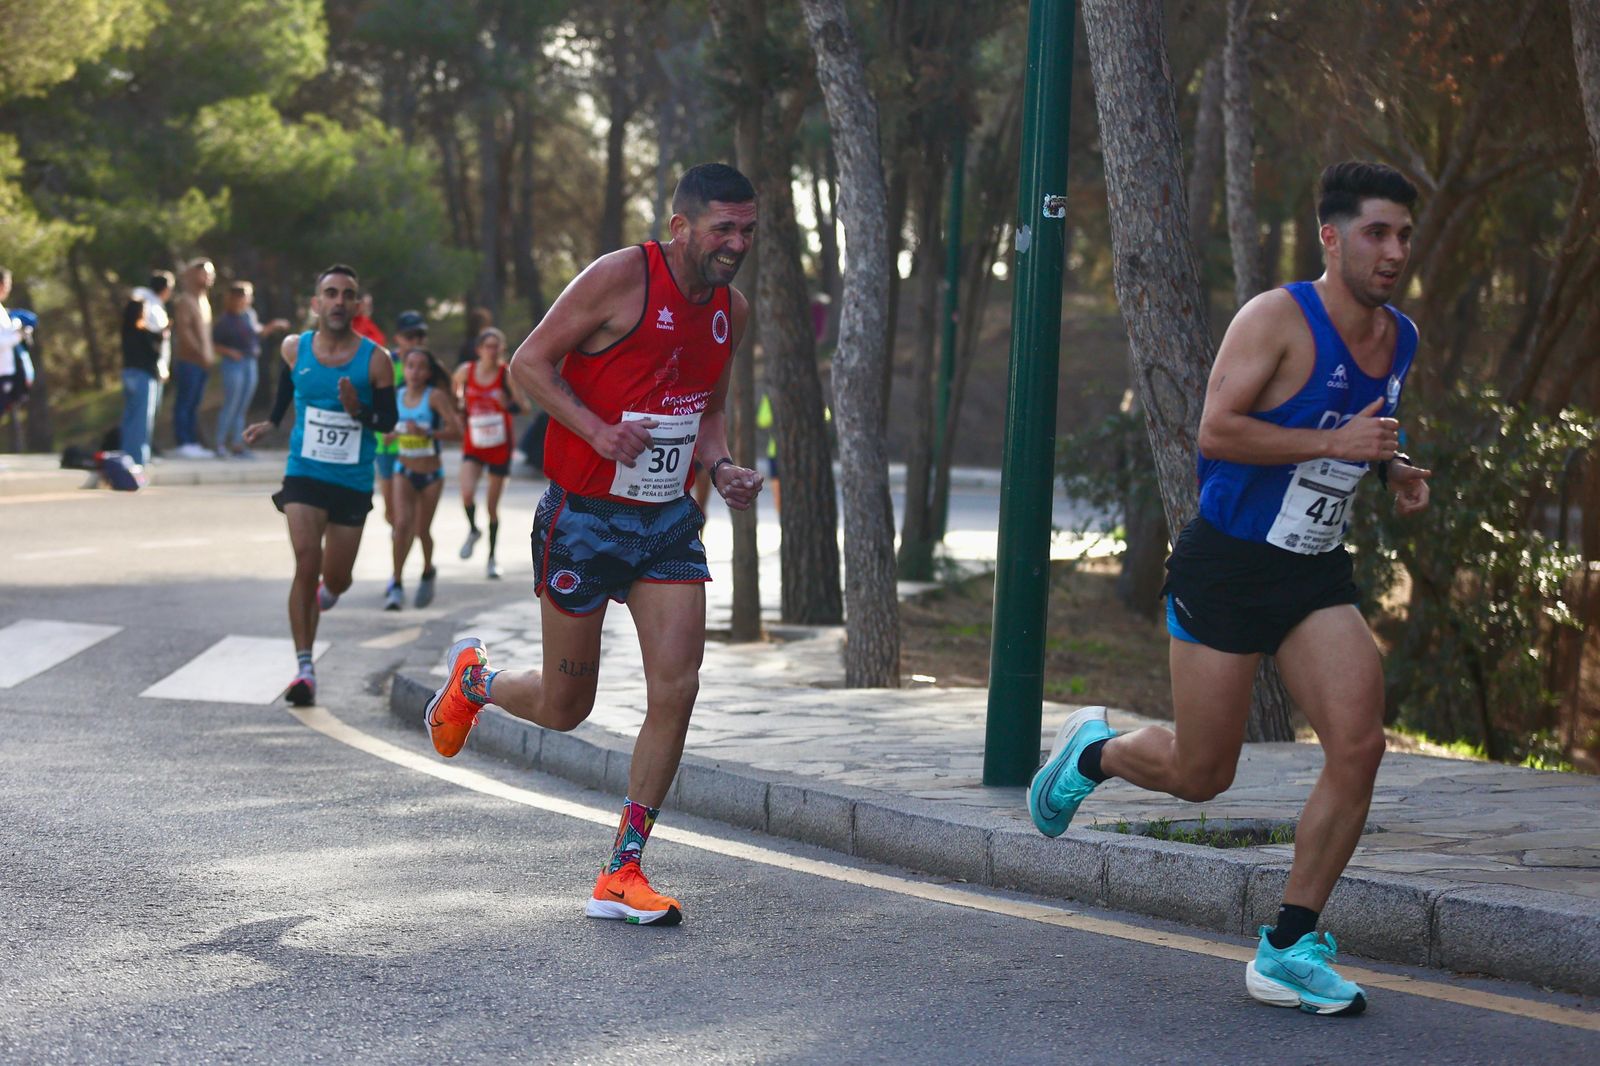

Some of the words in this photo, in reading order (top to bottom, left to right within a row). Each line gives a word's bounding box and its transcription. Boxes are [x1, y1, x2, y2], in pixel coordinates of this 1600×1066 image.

[316, 428, 350, 447] 197
[648, 447, 680, 474] 30
[1305, 496, 1348, 527] 411
